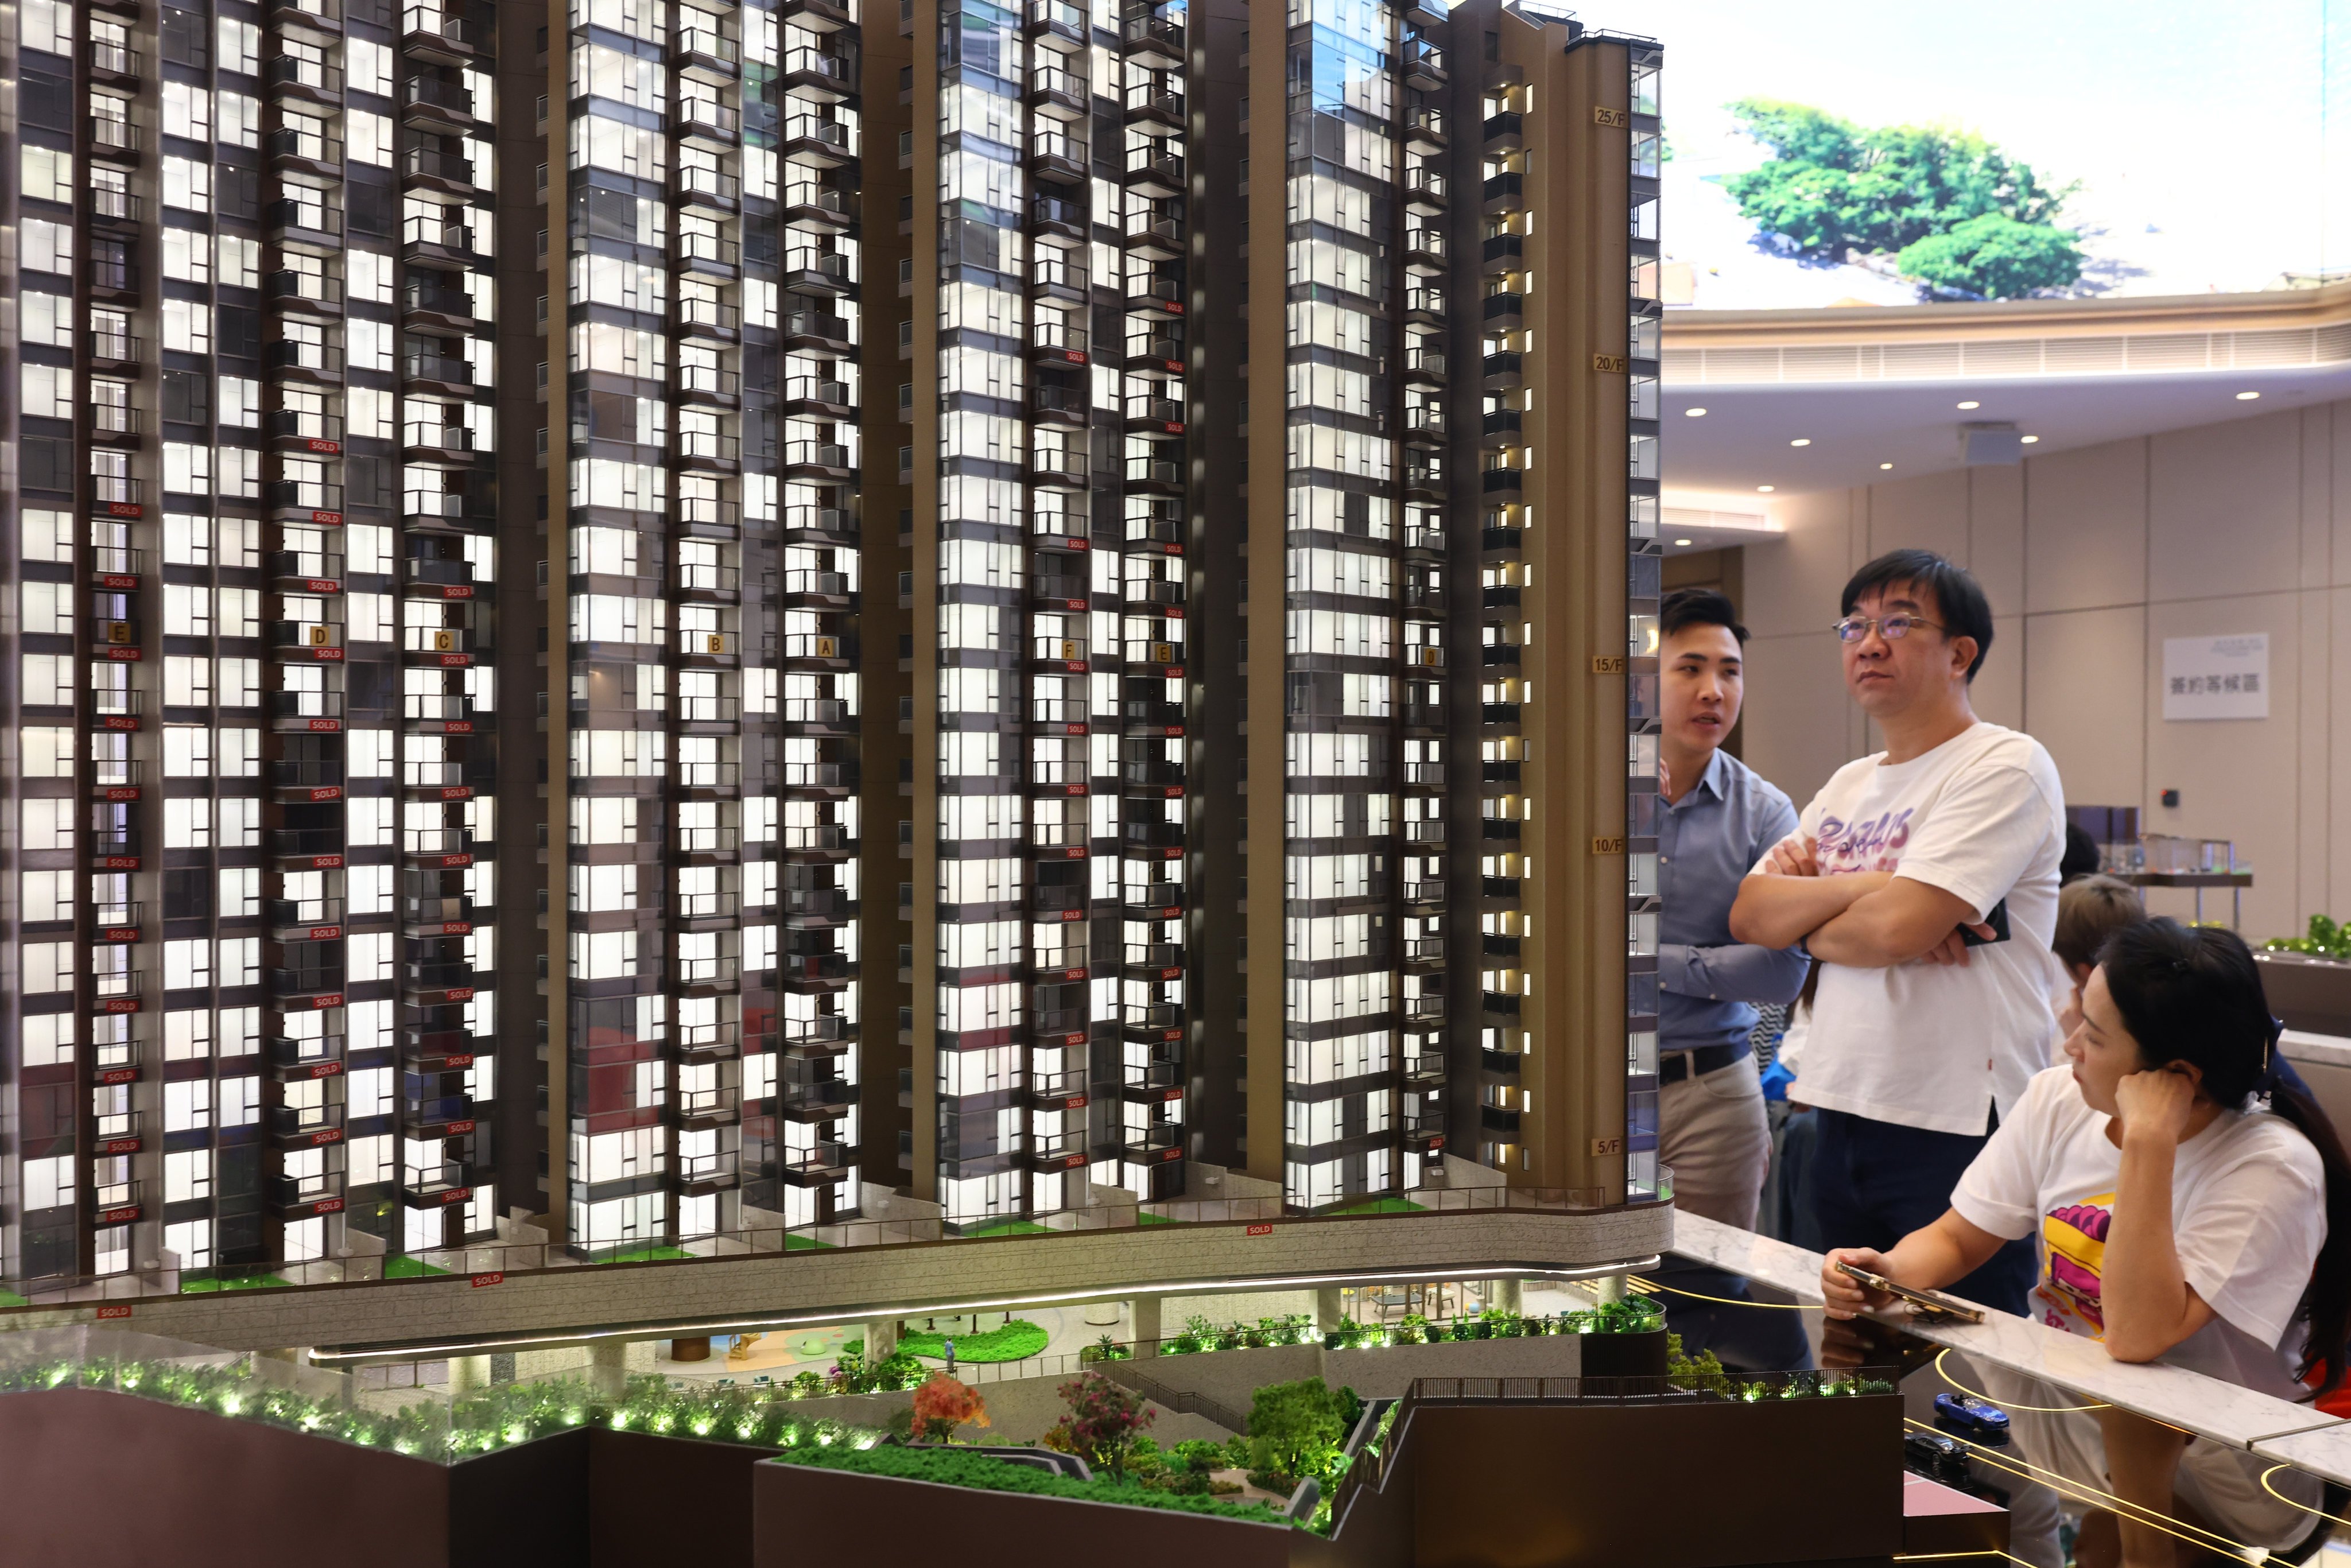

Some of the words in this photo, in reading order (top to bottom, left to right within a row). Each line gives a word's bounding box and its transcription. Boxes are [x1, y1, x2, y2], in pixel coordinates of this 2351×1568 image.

[1597, 109, 1625, 126] 25/F
[1167, 304, 1182, 312] SOLD
[1068, 352, 1084, 362] SOLD
[1168, 362, 1182, 371] SOLD
[1596, 356, 1624, 371] 20/F
[1168, 424, 1182, 432] SOLD
[312, 441, 335, 451] SOLD
[113, 505, 138, 515] SOLD
[316, 513, 339, 523] SOLD
[108, 578, 134, 587] SOLD
[311, 581, 334, 591] SOLD
[115, 626, 125, 640] E
[315, 629, 325, 643] D
[439, 634, 449, 649] C
[712, 637, 720, 651] B
[821, 641, 831, 654] A
[1065, 644, 1072, 657] F
[112, 650, 137, 658] SOLD
[317, 647, 341, 658] SOLD
[1161, 647, 1167, 660] E
[1428, 651, 1433, 663] D
[444, 656, 465, 664] SOLD
[1596, 658, 1622, 672] 15/F
[109, 719, 134, 728] SOLD
[312, 721, 336, 729] SOLD
[448, 723, 470, 731] SOLD
[110, 790, 135, 798] SOLD
[314, 789, 337, 799] SOLD
[445, 789, 467, 797] SOLD
[1595, 839, 1622, 852] 10/F
[110, 859, 135, 867] SOLD
[316, 857, 340, 866] SOLD
[446, 856, 468, 864] SOLD
[1165, 909, 1179, 917] SOLD
[446, 924, 468, 932] SOLD
[110, 931, 135, 939] SOLD
[313, 929, 337, 938] SOLD
[1068, 971, 1083, 979] SOLD
[1164, 969, 1178, 978] SOLD
[450, 990, 472, 999] SOLD
[316, 996, 340, 1006] SOLD
[110, 1002, 135, 1010] SOLD
[1068, 1035, 1084, 1043] SOLD
[449, 1056, 471, 1065] SOLD
[315, 1065, 337, 1076] SOLD
[107, 1072, 133, 1082] SOLD
[1167, 1091, 1181, 1099] SOLD
[1069, 1099, 1084, 1107] SOLD
[451, 1123, 472, 1132] SOLD
[316, 1131, 339, 1143] SOLD
[111, 1142, 137, 1151] SOLD
[1598, 1139, 1619, 1154] 5/F
[1166, 1150, 1180, 1158] SOLD
[1068, 1157, 1084, 1165] SOLD
[445, 1191, 467, 1201] SOLD
[317, 1201, 340, 1212] SOLD
[110, 1210, 135, 1220] SOLD
[1250, 1225, 1270, 1235] SOLD
[475, 1275, 500, 1286] SOLD
[101, 1307, 128, 1317] SOLD
